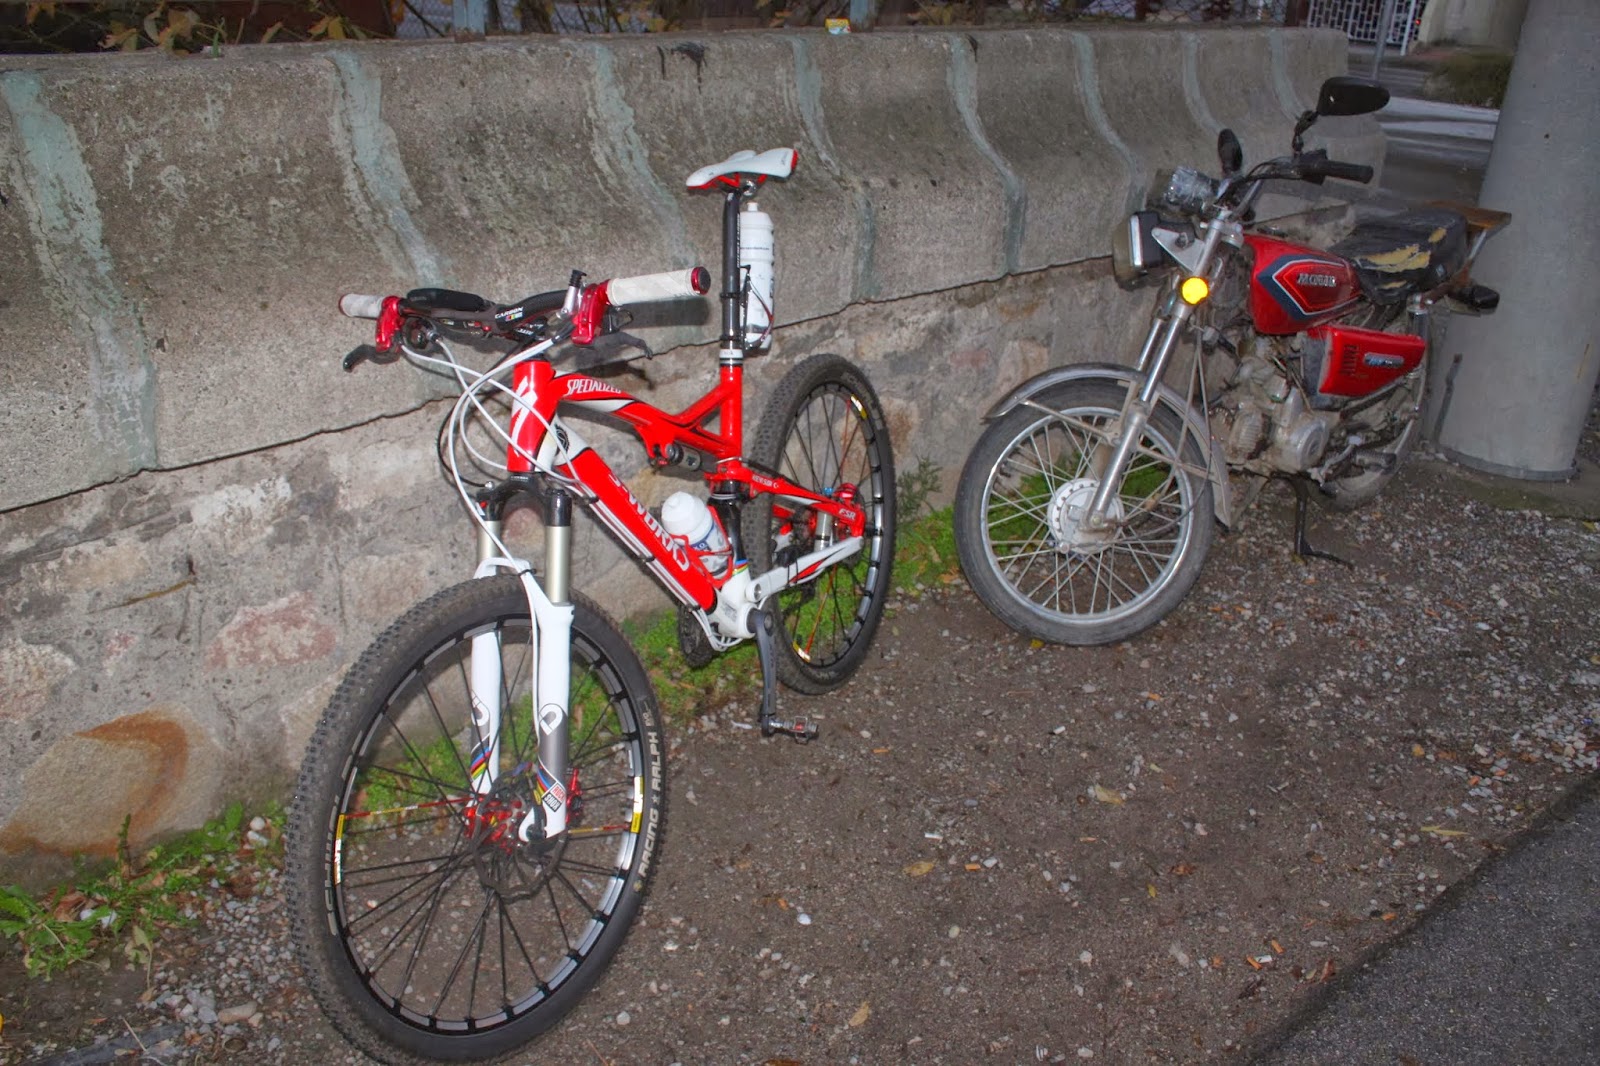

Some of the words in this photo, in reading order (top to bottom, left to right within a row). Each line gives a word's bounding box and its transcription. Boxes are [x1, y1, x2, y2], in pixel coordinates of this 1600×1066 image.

[494, 306, 524, 319] CARBON
[566, 378, 622, 395] SPECIALIZED
[648, 731, 662, 792] RALPH
[543, 793, 560, 811] SHOX
[638, 808, 659, 878] RACING
